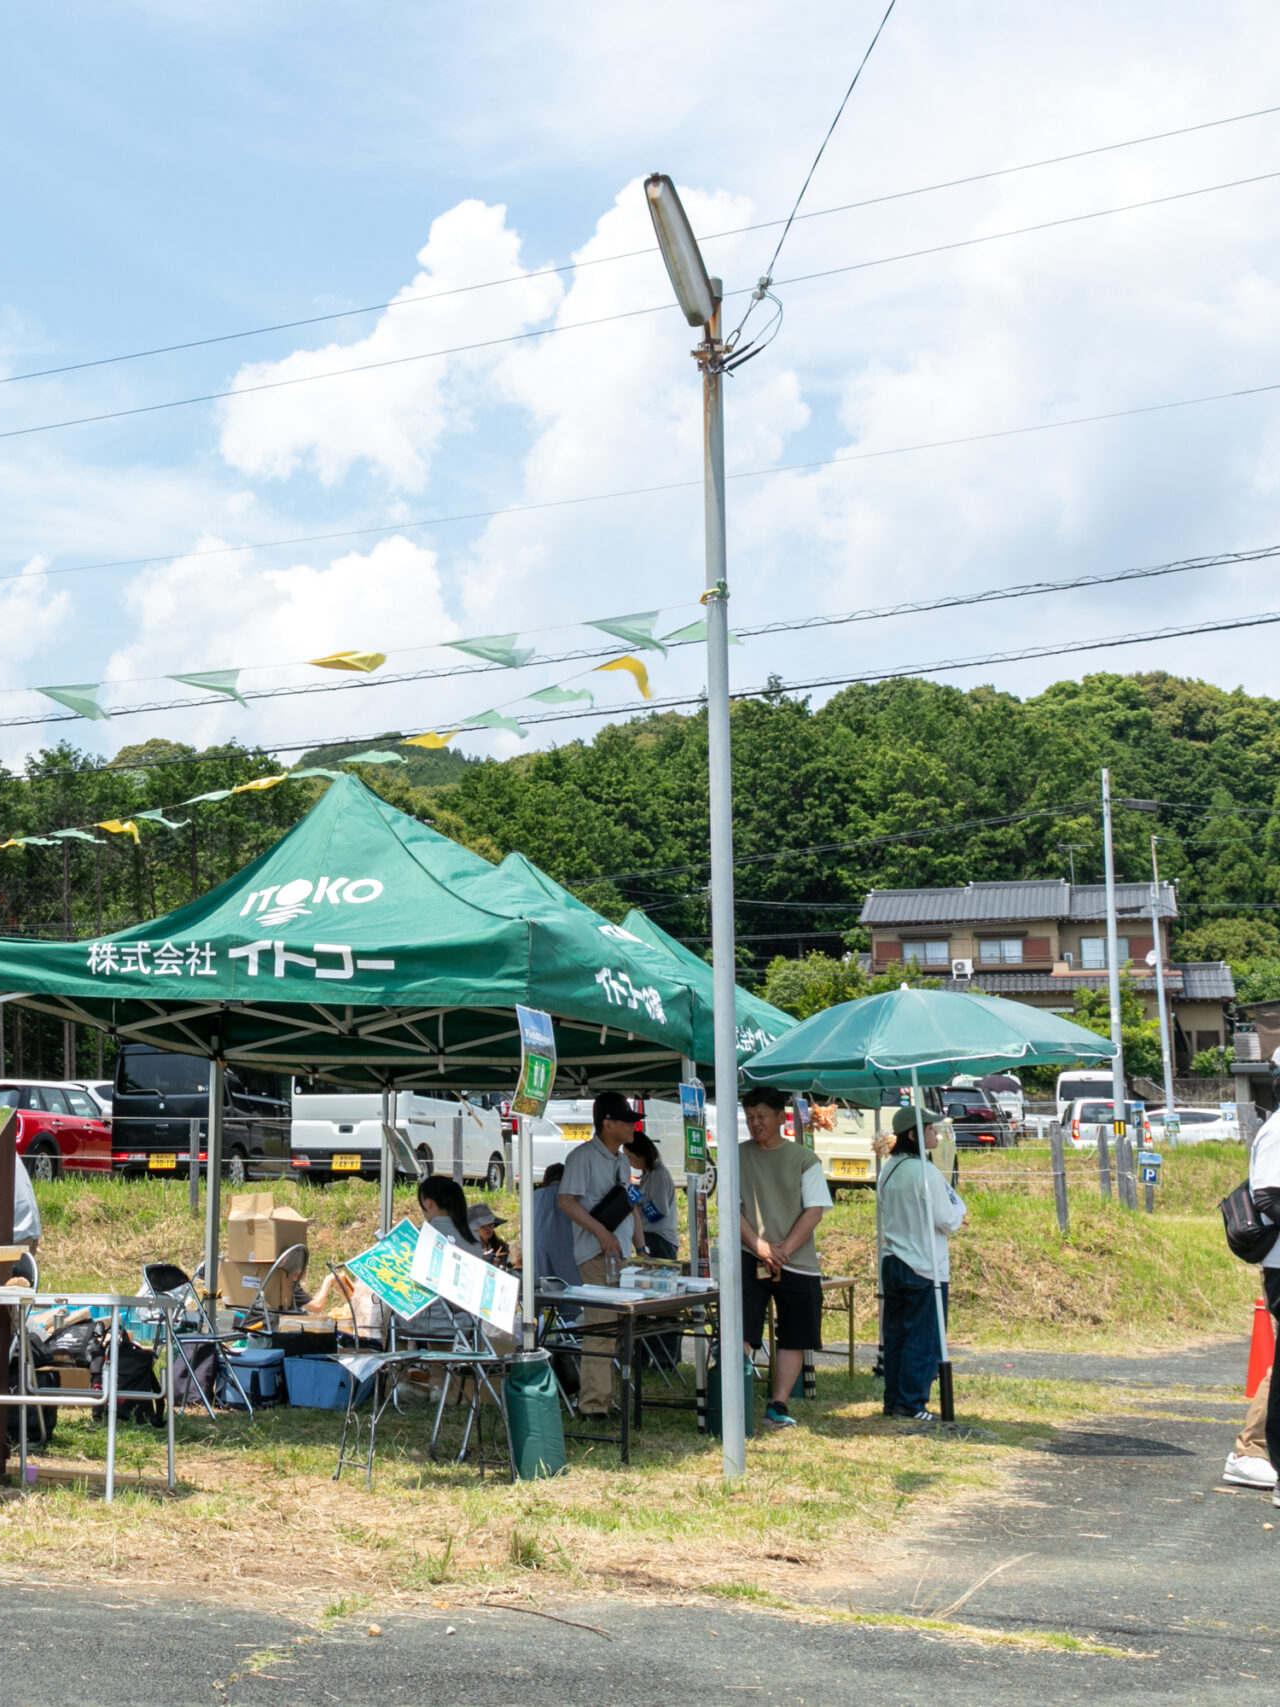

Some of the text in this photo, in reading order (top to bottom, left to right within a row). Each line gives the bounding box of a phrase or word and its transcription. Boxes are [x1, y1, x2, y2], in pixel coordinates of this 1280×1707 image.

[239, 876, 384, 918] ITOKO
[86, 940, 395, 979] 株式会社 イトコー
[1146, 1168, 1155, 1181] P
